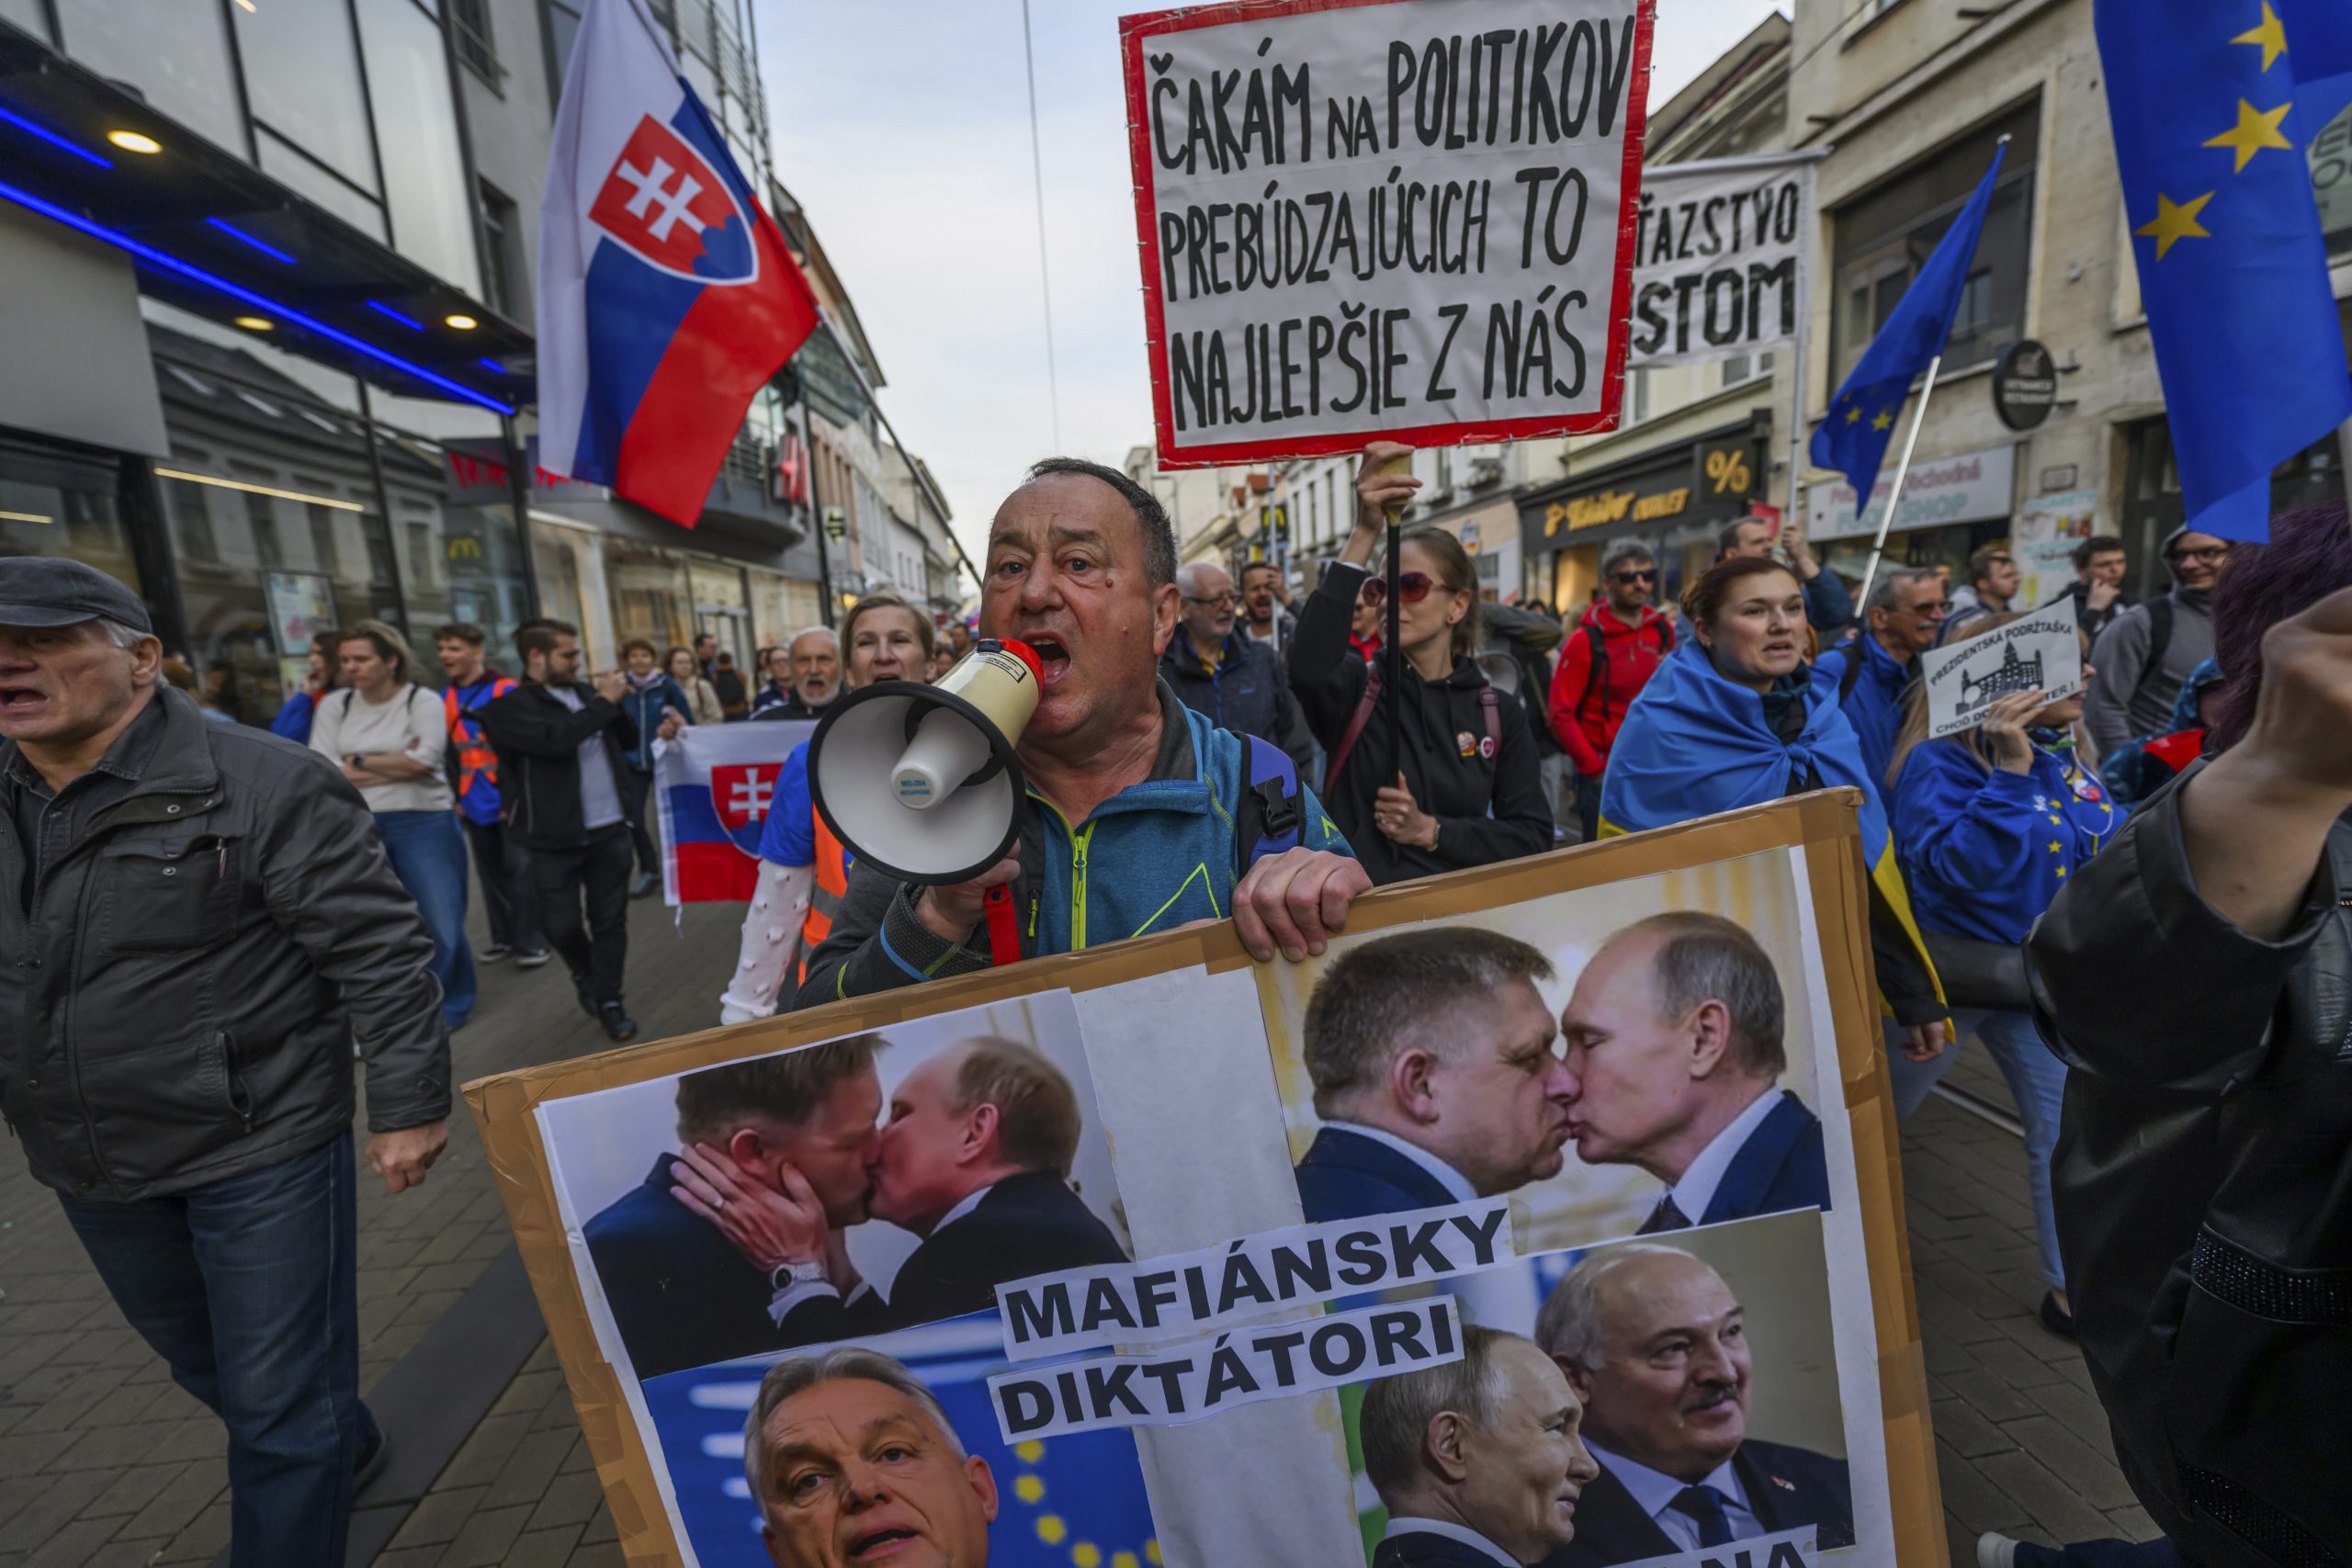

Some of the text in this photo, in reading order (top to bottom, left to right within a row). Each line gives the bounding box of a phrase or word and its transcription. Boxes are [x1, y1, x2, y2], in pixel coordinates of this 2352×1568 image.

[1150, 16, 1635, 174] ČAKÁM NA POLITIKOV
[1160, 165, 1589, 302] PREBÚDZAJÚCICH TO
[1170, 285, 1588, 431] NAJLEPŠIE Z NÁS
[1627, 256, 1798, 360] STOM
[1005, 1208, 1509, 1344] MAFIÁNSKY
[998, 1303, 1454, 1435] DIKTÁTORI
